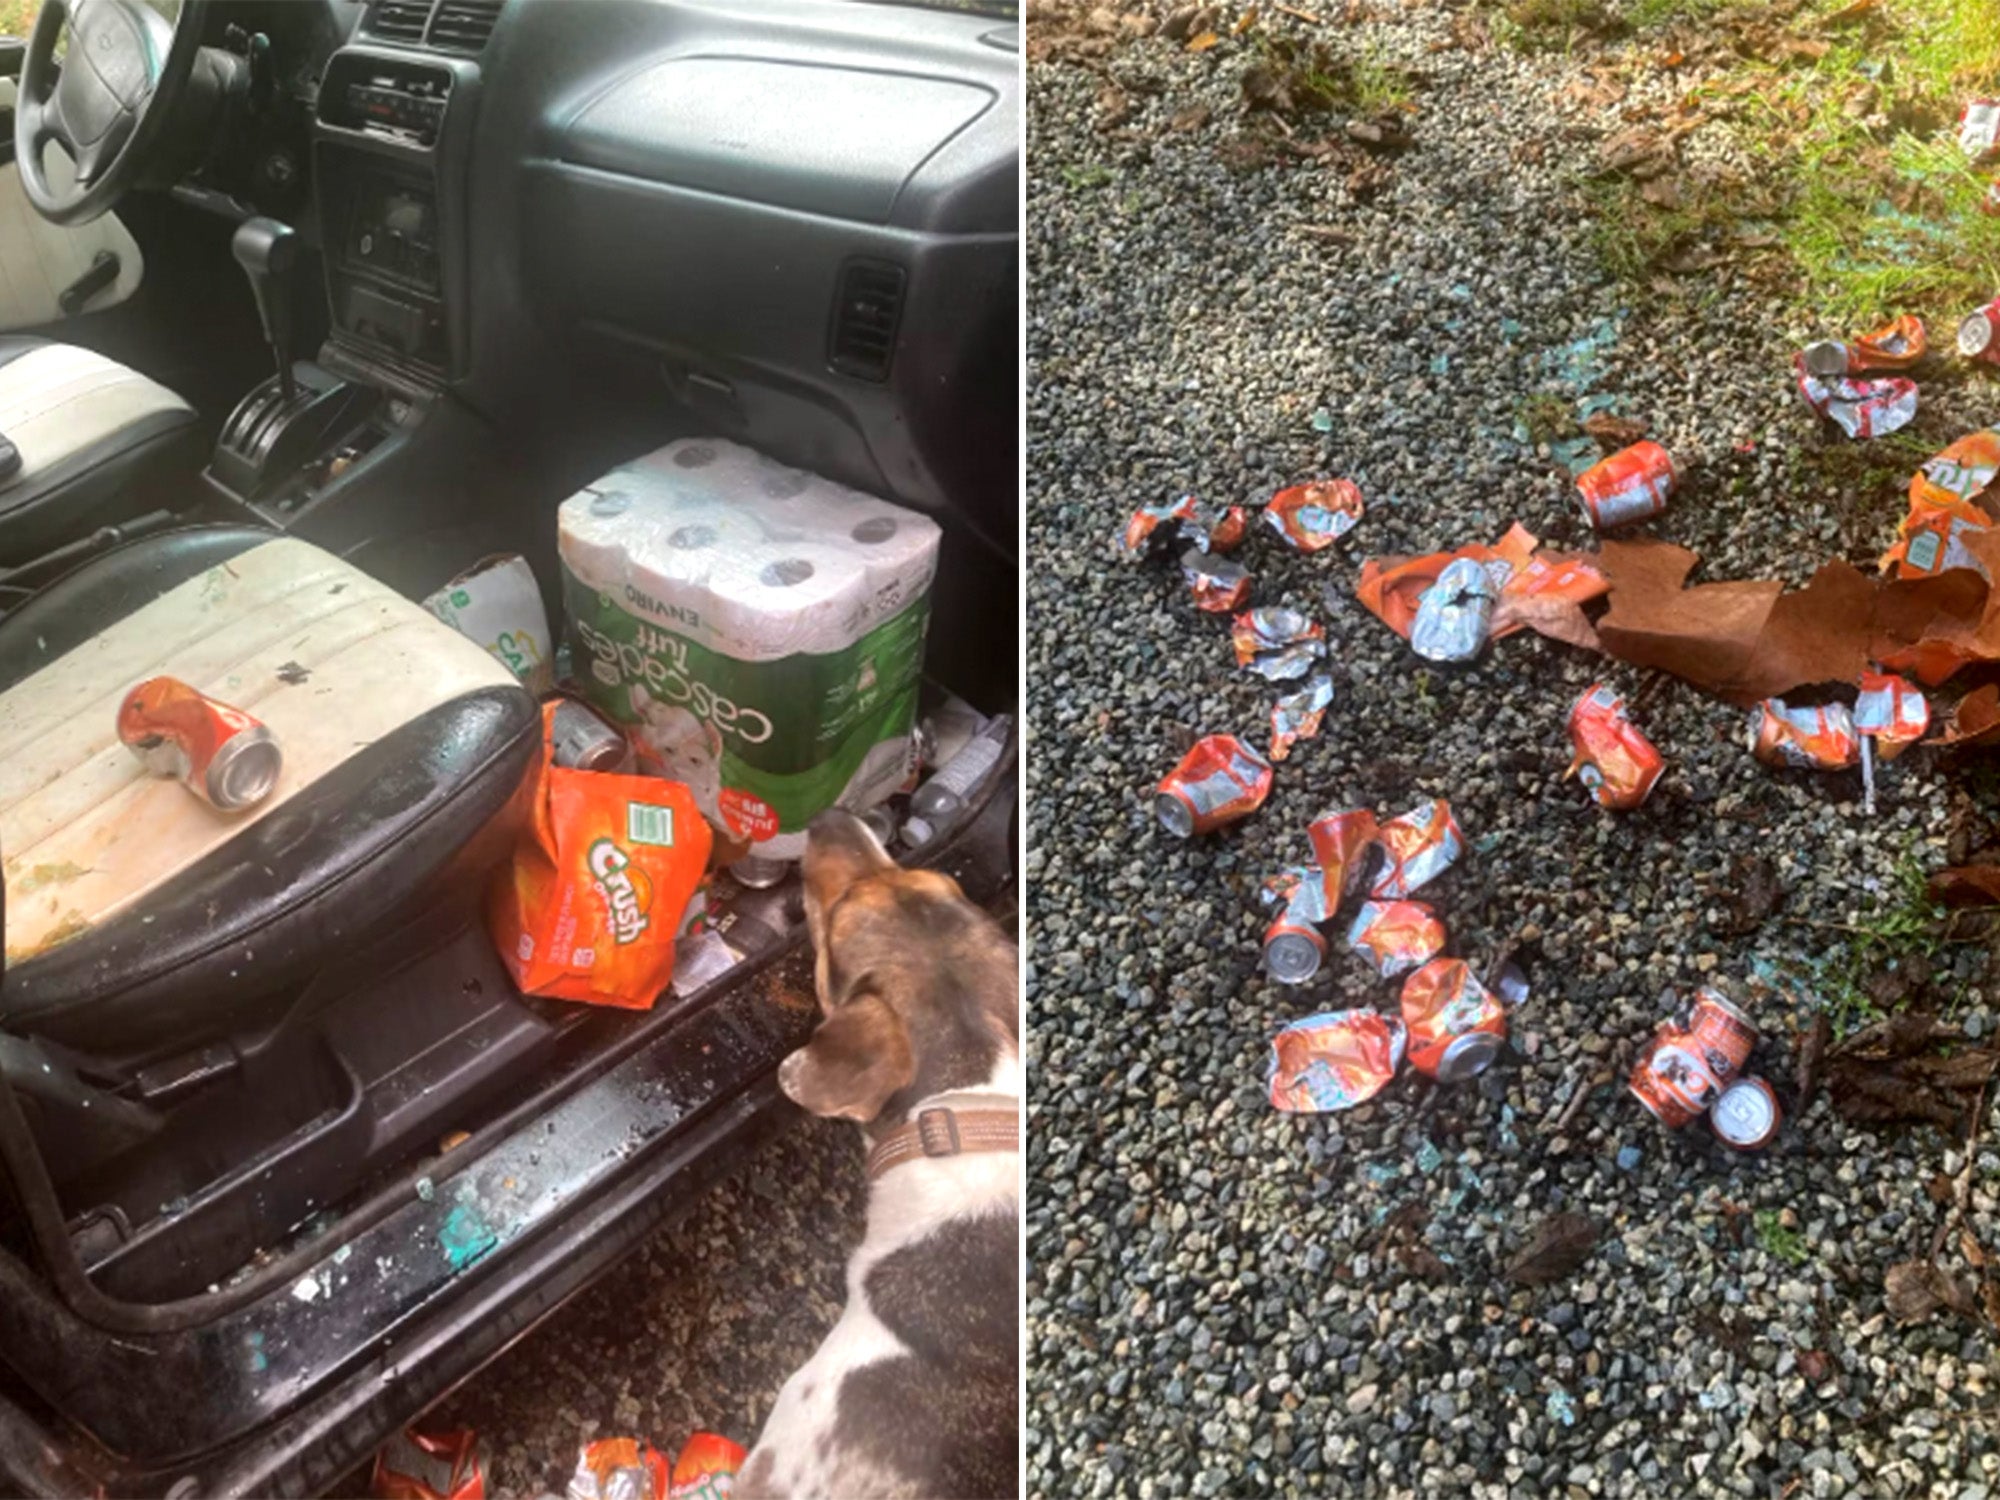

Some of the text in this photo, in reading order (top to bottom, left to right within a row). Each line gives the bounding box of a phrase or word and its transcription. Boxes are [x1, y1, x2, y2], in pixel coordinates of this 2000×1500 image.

[623, 585, 700, 627] ENVIRO
[634, 624, 690, 675] Tuff
[589, 840, 648, 944] Crush
